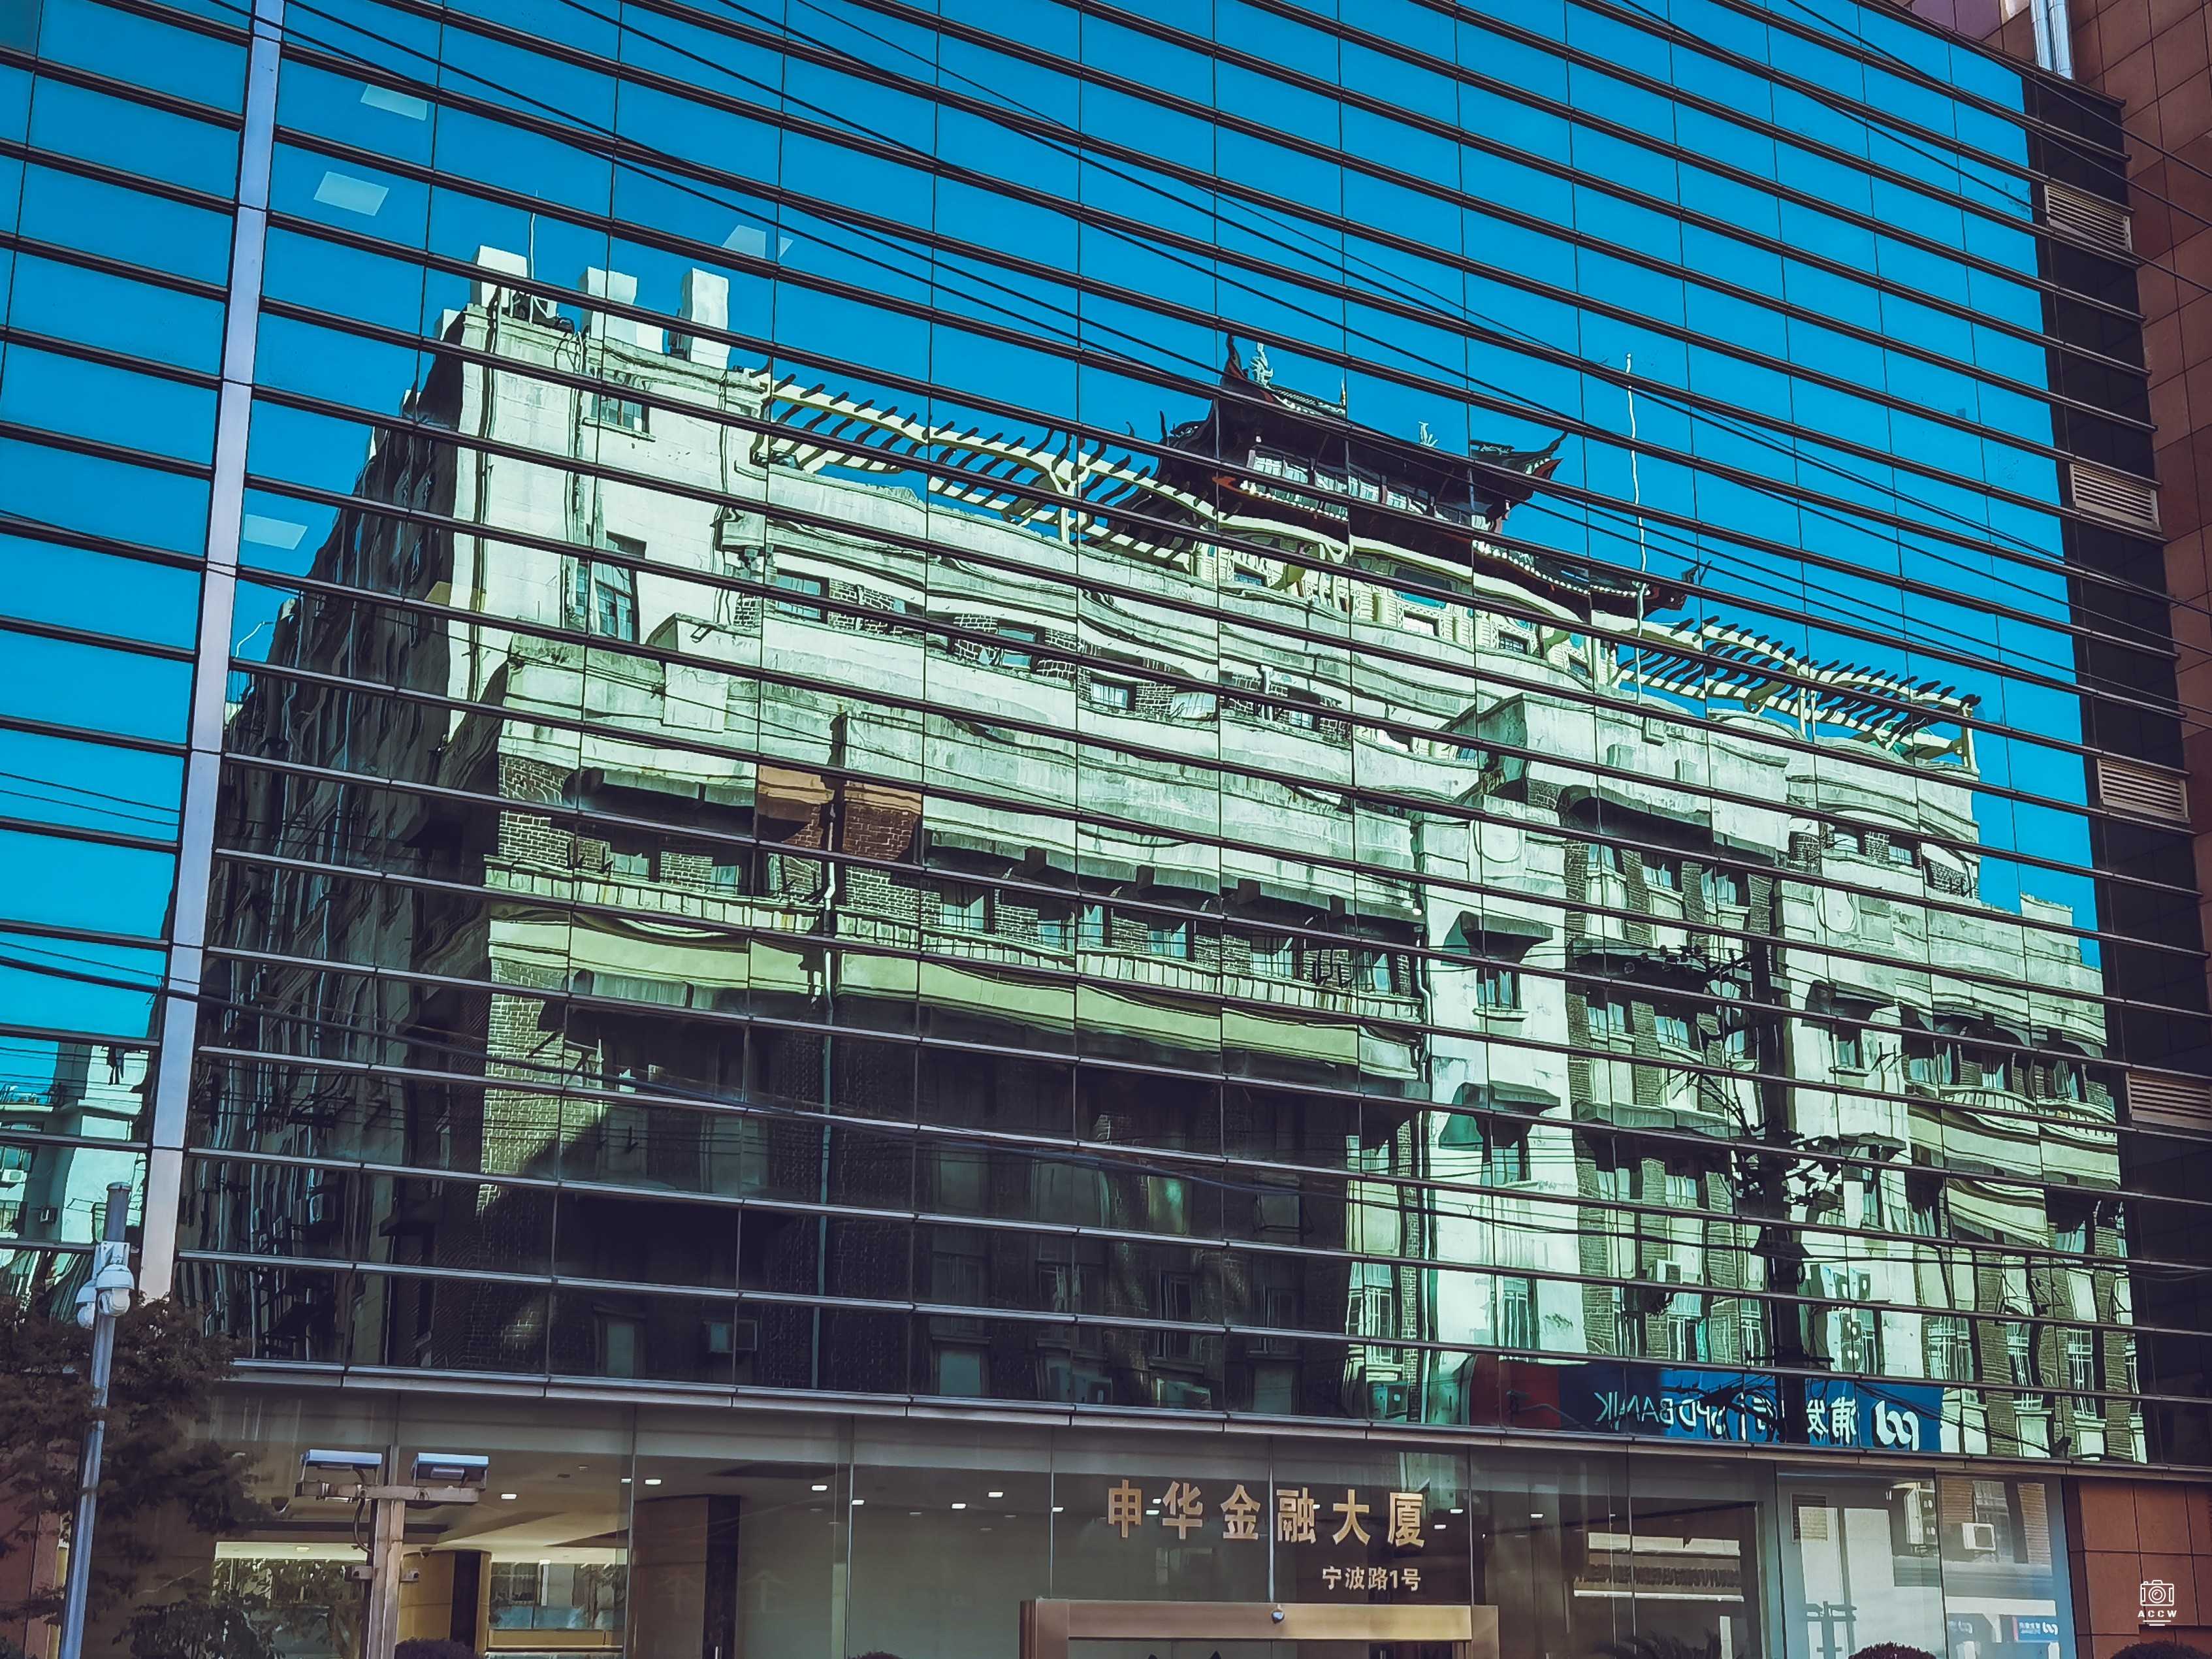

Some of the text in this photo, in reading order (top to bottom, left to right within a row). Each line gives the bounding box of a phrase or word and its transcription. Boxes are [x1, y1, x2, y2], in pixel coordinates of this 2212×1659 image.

[1108, 1479, 1425, 1547] 申华金融大厦
[1322, 1566, 1421, 1591] 宁波路1号
